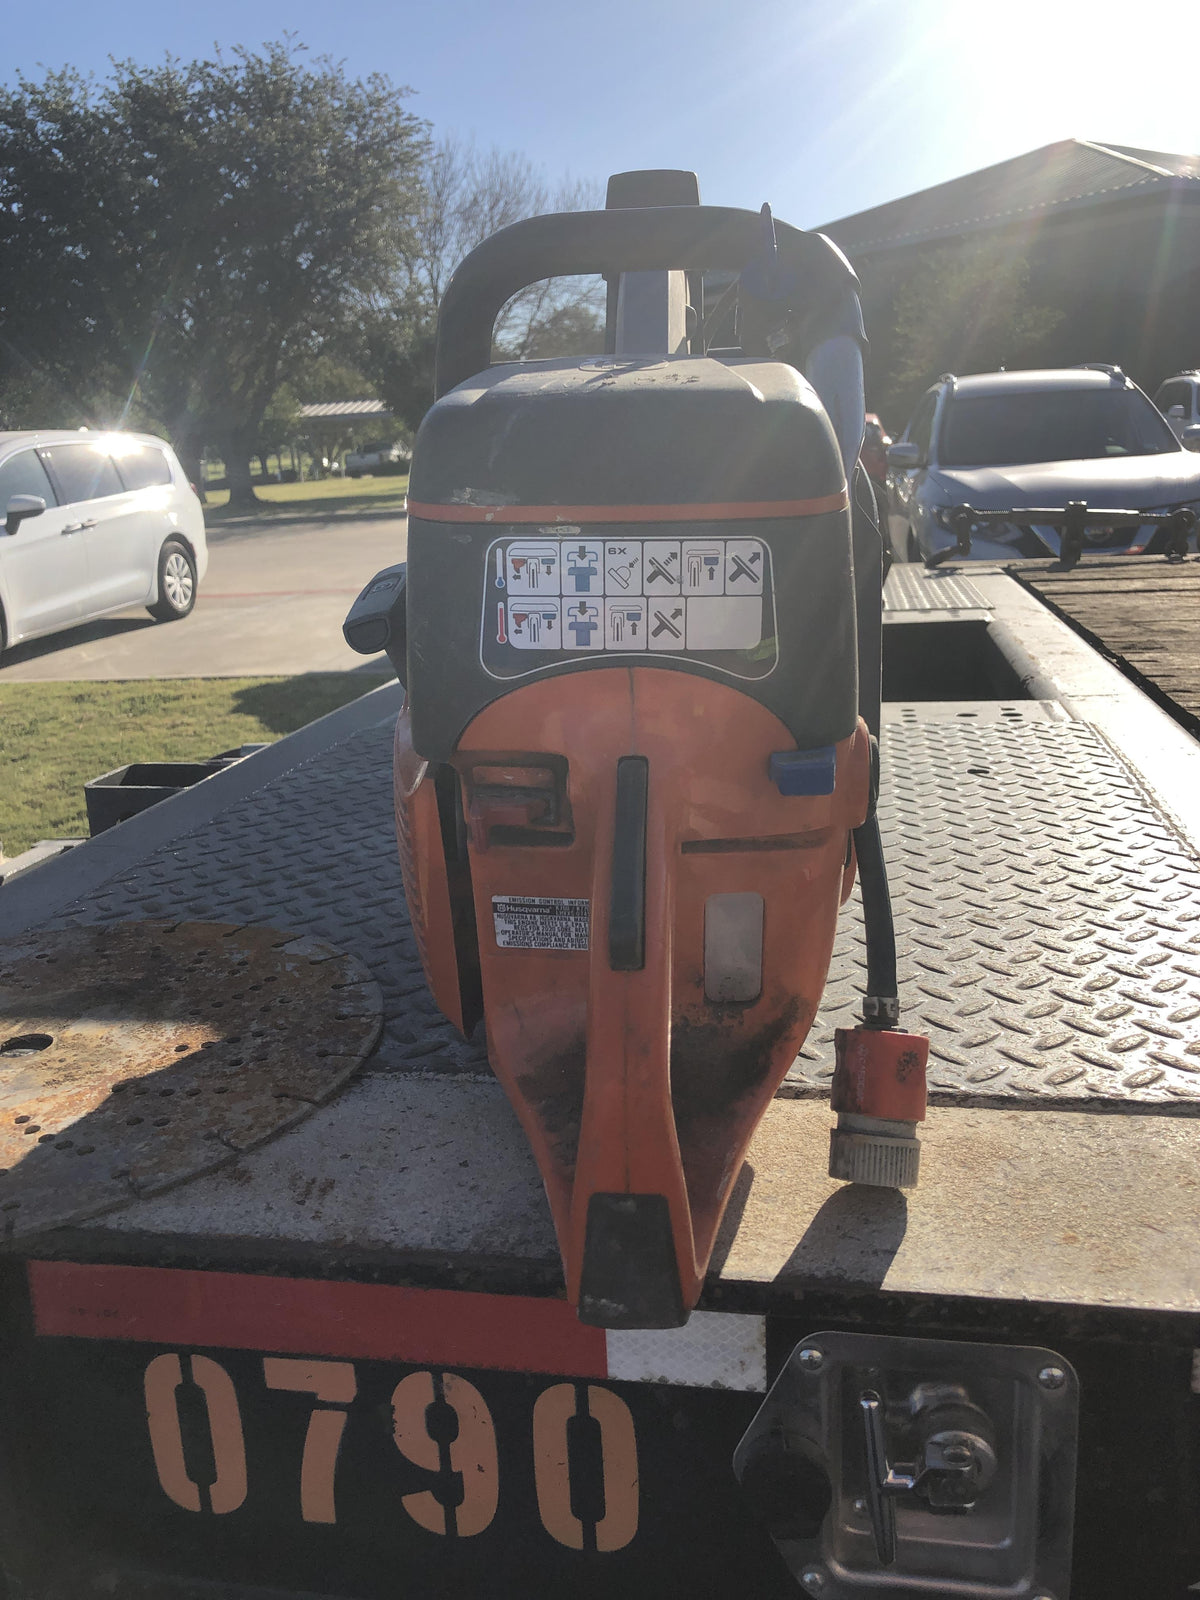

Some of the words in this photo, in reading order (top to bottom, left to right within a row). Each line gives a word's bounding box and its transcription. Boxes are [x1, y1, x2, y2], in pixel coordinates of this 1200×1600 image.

[608, 547, 627, 555] 6X
[506, 904, 550, 914] Husqvarna
[143, 1352, 640, 1552] 0790
